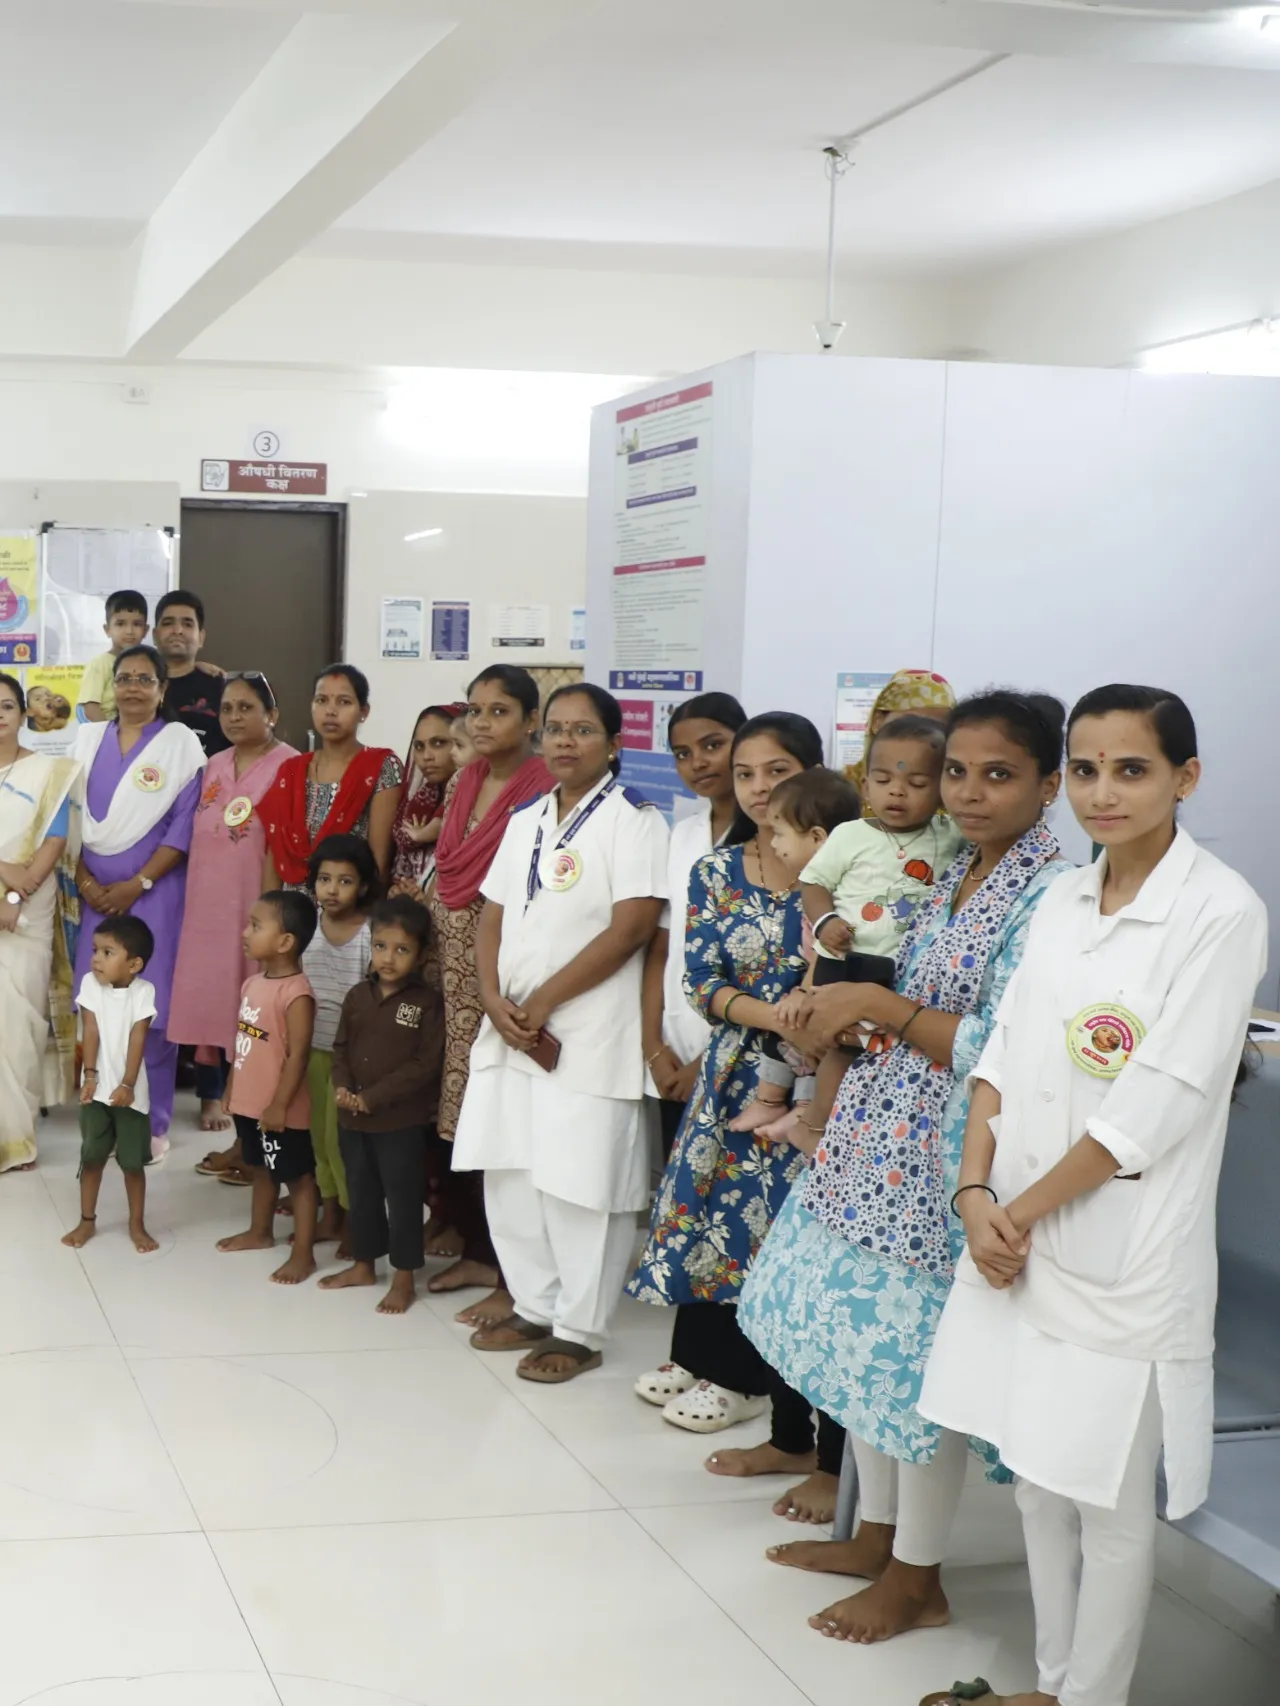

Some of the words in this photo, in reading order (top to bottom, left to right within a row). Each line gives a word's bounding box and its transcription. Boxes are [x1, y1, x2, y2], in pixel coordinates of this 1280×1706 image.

[261, 436, 272, 452] 3
[238, 463, 277, 477] औषधी
[278, 463, 318, 479] वितरण
[265, 478, 290, 491] कक्ष
